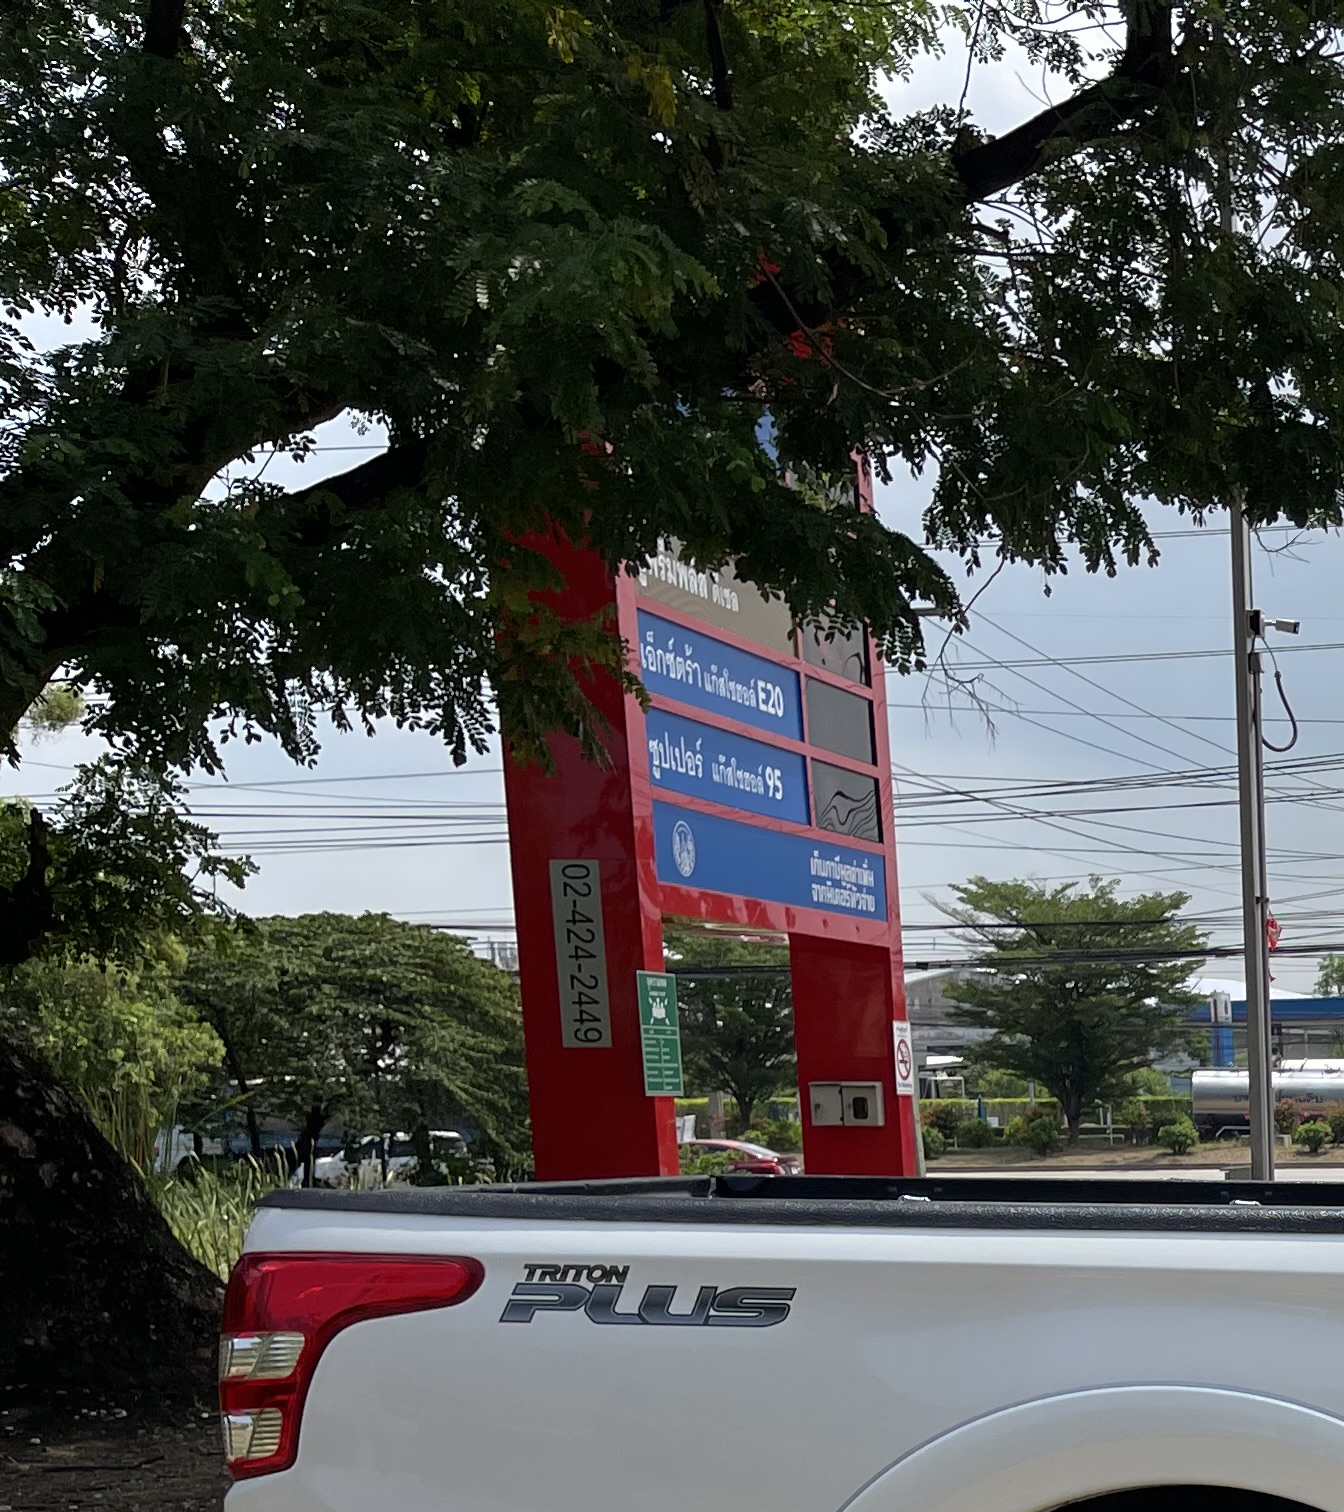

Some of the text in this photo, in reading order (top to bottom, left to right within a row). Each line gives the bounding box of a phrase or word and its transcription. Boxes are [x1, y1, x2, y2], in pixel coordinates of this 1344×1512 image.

[757, 679, 784, 717] E20
[765, 766, 783, 800] 95
[561, 863, 603, 1043] 02-424-2449
[523, 1263, 630, 1284] TRITON
[498, 1282, 797, 1328] PLUS
